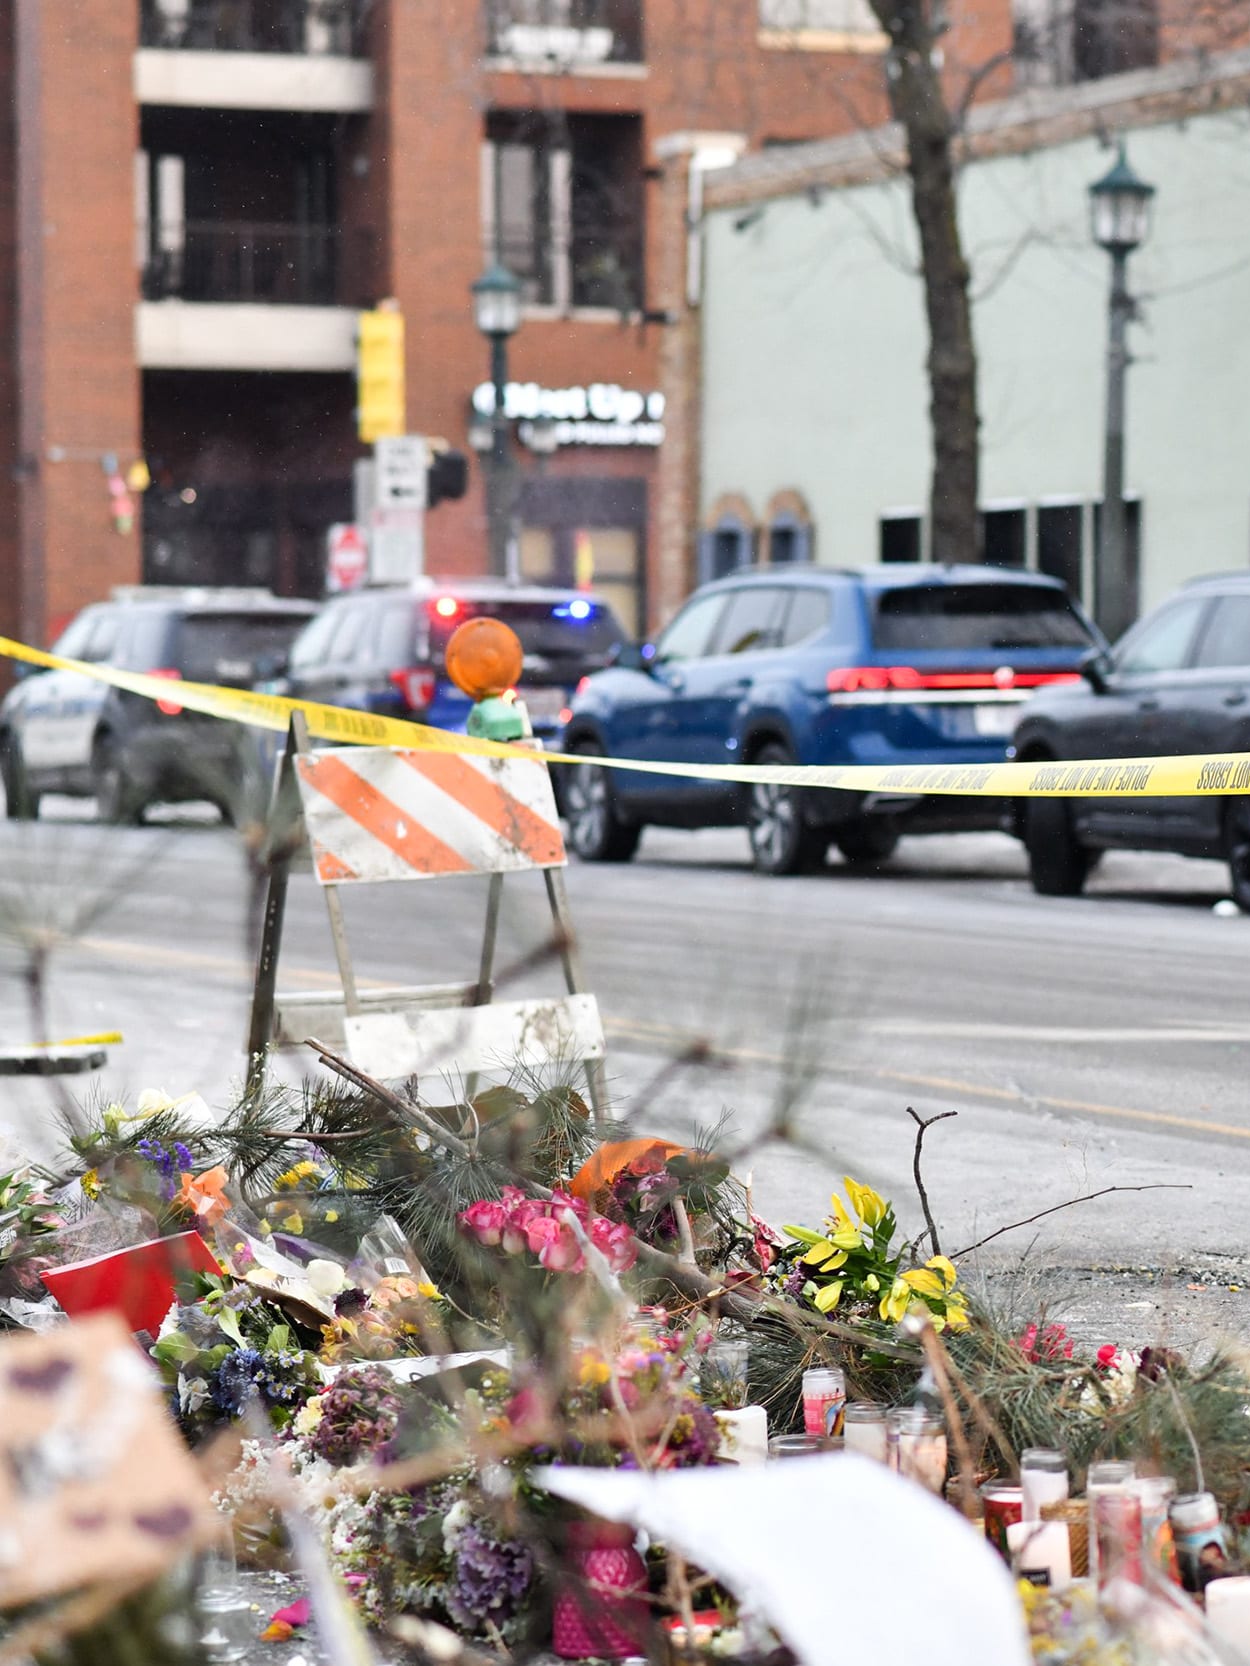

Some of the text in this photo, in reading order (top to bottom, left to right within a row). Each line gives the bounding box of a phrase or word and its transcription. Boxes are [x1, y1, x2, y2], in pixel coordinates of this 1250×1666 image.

[1059, 767, 1086, 791] NOT
[1080, 767, 1100, 791] DO
[1094, 766, 1122, 791] LINE
[1116, 765, 1155, 791] POLICE
[1197, 760, 1234, 790] CROSS
